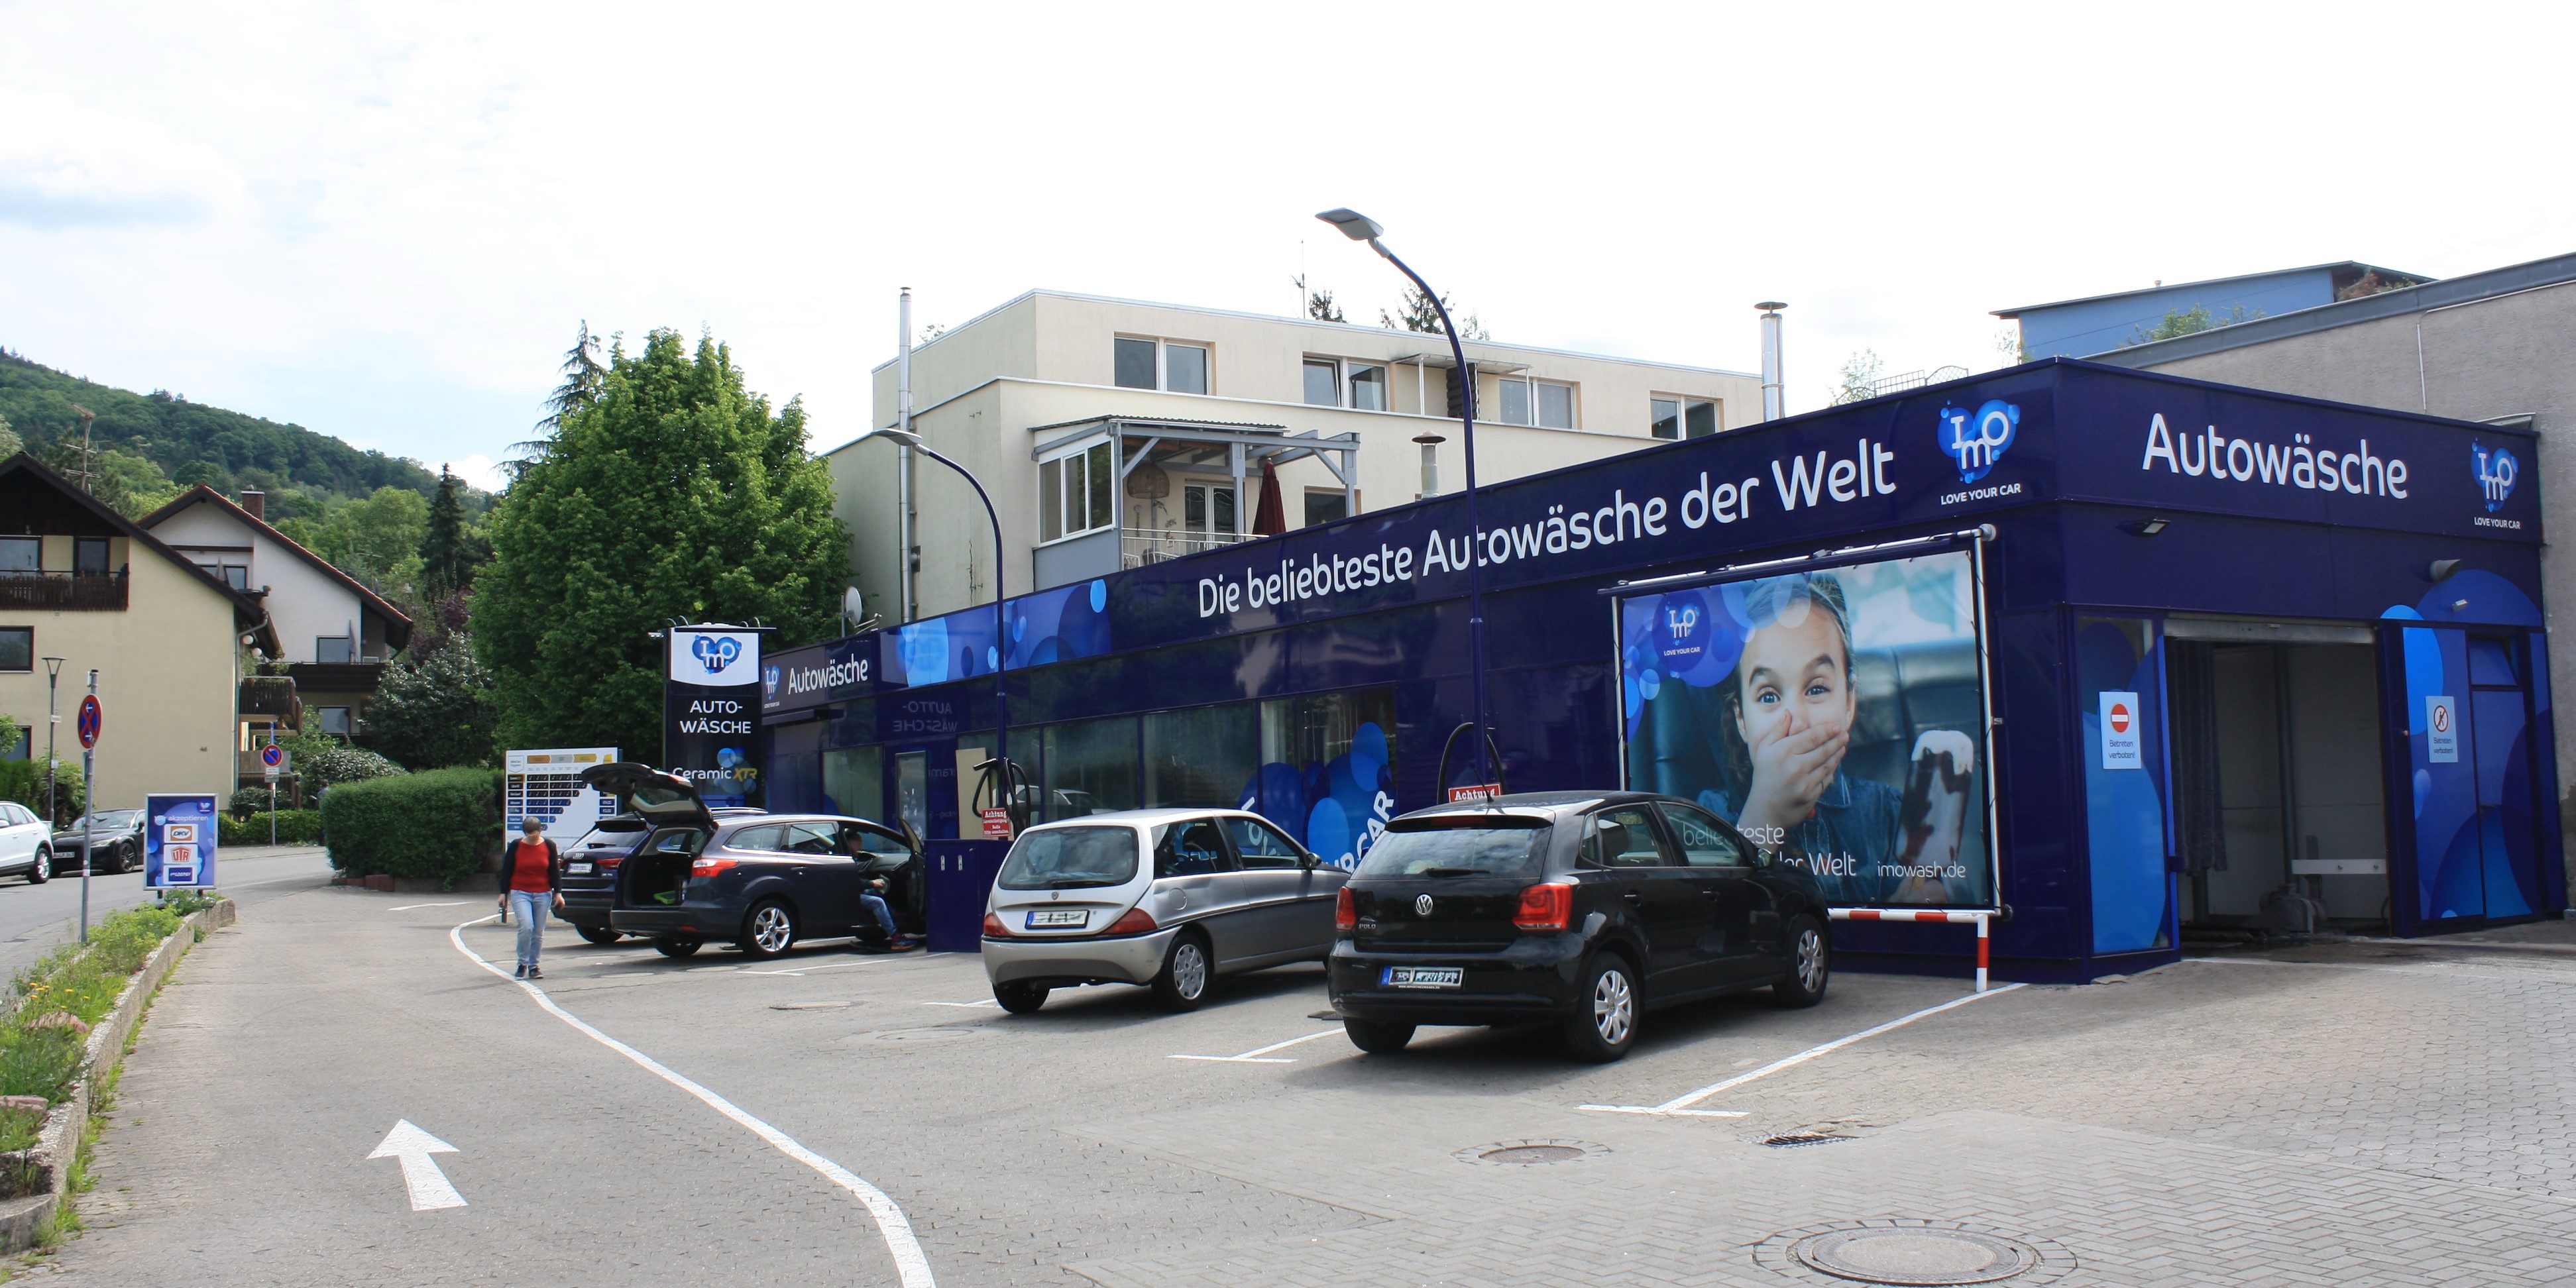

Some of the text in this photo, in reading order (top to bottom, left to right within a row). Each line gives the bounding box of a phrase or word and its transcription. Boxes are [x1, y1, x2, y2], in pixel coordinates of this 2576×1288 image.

[2142, 413, 2408, 499] Autowäsche
[1941, 483, 2021, 505] LOVE YOUR CAR
[1199, 439, 1896, 617] Die beliebteste Autowäsche der Welt
[2474, 517, 2520, 529] LOVE YOUR CAR
[788, 653, 868, 694] Autowäsche
[690, 700, 743, 714] AUTO-
[679, 718, 752, 733] WÄSCHE
[673, 767, 757, 782] Ceramic XTR
[1809, 851, 1856, 877] Welt
[1877, 861, 1966, 878] imowash.de
